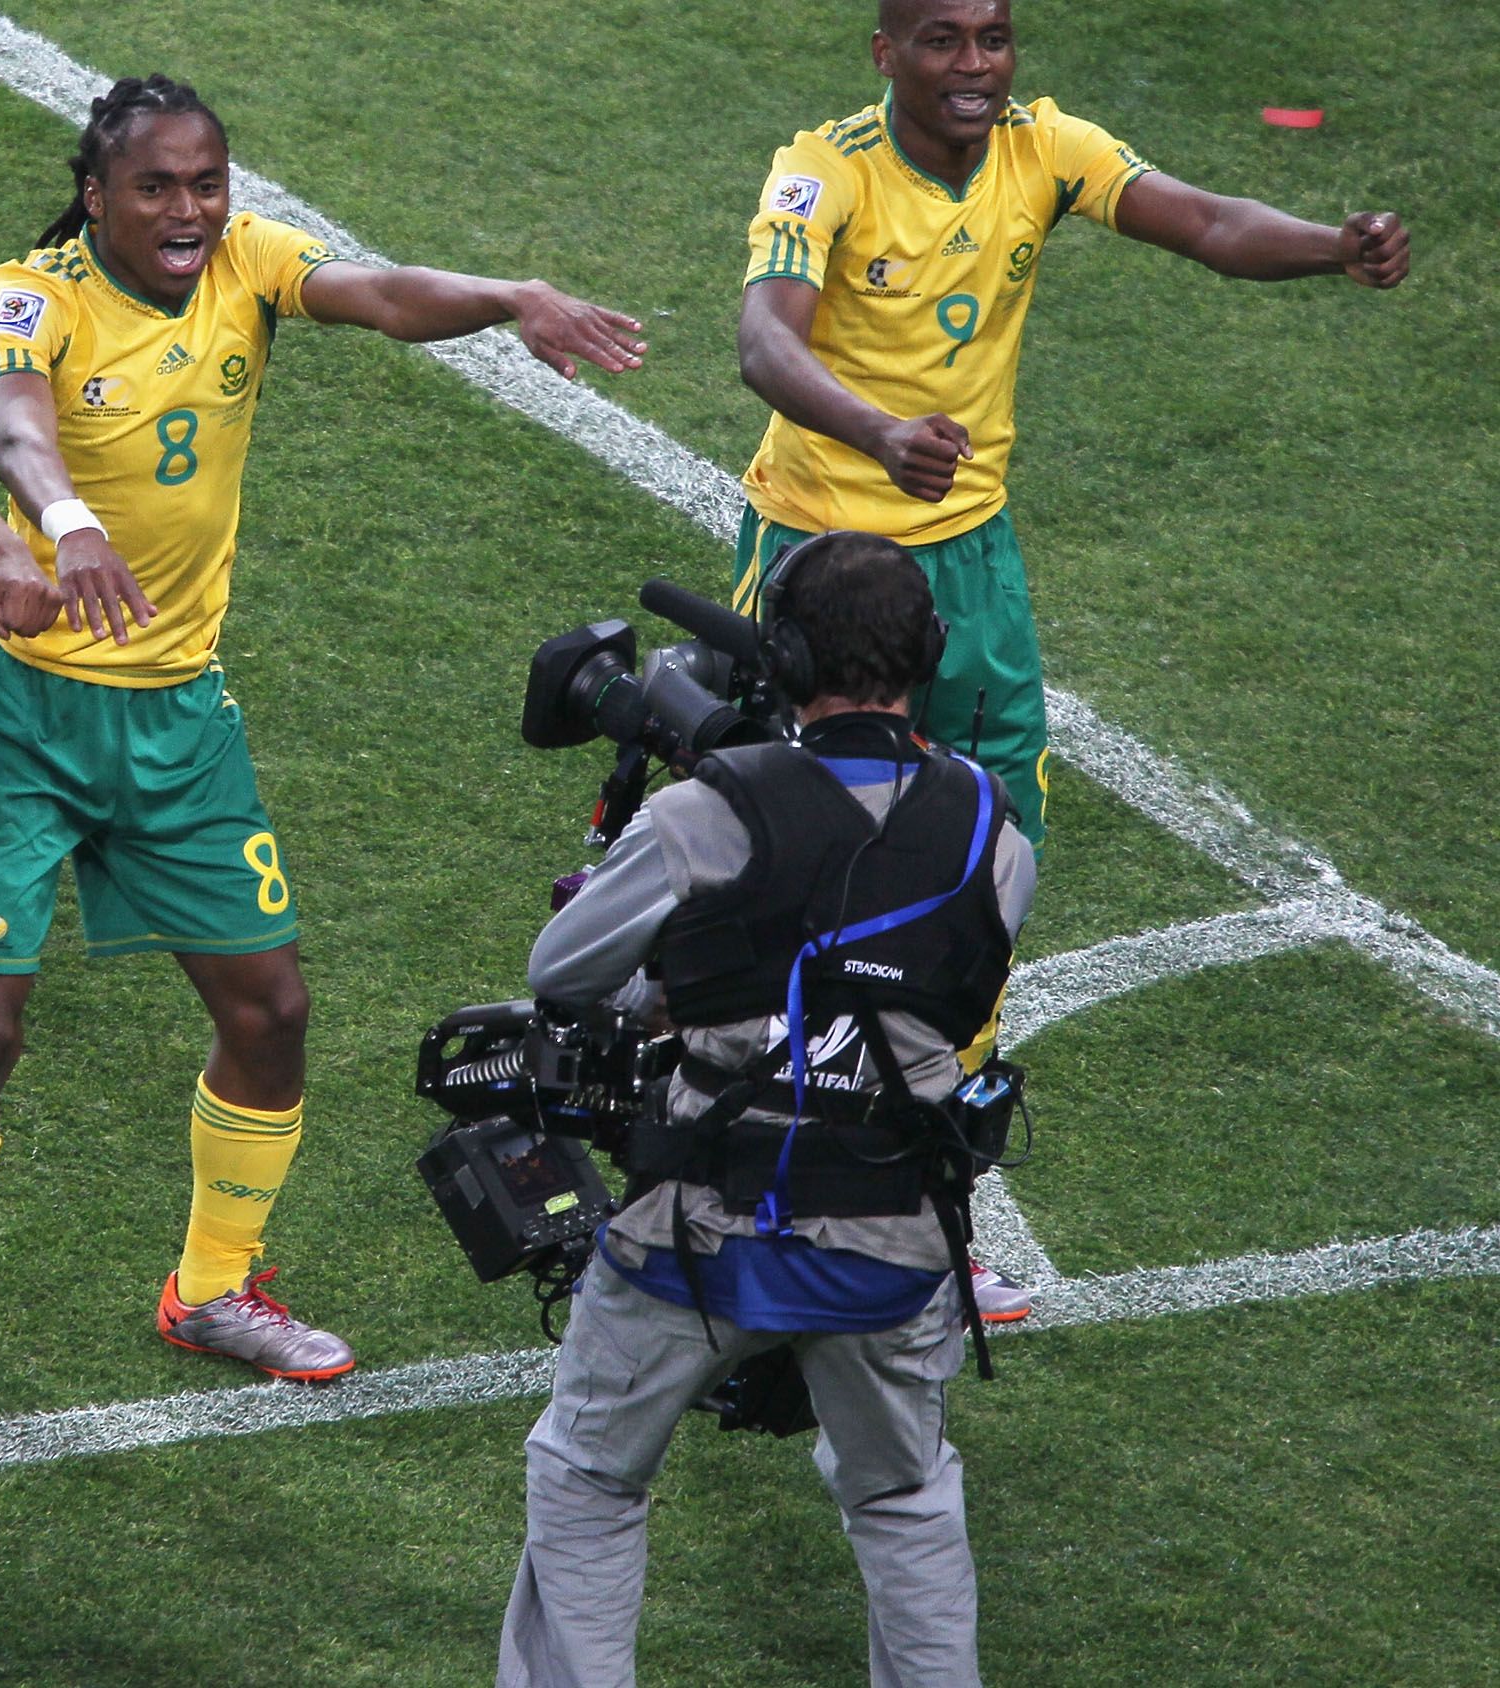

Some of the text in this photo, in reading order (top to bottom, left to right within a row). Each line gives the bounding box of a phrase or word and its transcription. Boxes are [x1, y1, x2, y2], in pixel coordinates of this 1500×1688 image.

[941, 241, 980, 257] addas
[936, 293, 980, 369] 9
[156, 355, 196, 376] adidas
[155, 408, 198, 486] 8
[243, 832, 290, 915] 8
[844, 959, 904, 981] STEADICAM
[208, 1180, 279, 1203] SAFA
